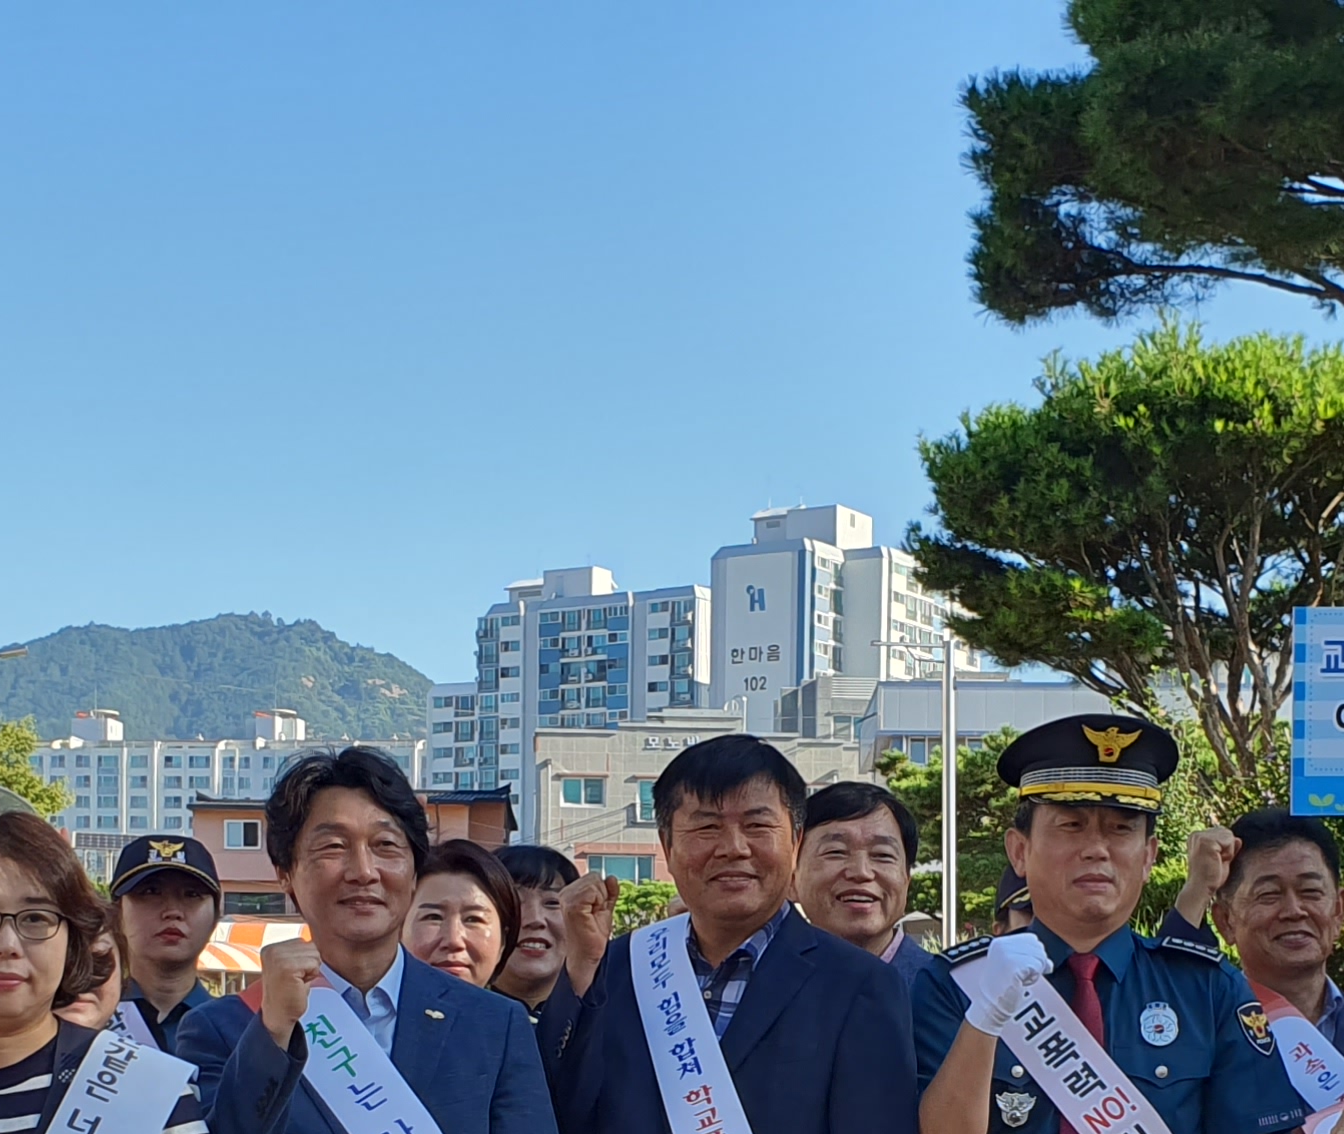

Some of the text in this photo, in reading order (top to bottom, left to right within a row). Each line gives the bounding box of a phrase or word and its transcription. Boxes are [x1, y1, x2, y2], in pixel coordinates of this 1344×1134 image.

[731, 644, 781, 664] 한마음
[744, 676, 767, 691] 102
[646, 927, 674, 992] 우리모두
[657, 992, 688, 1037] 힘을
[305, 1014, 387, 1111] 친구는
[669, 1037, 703, 1080] 합쳐
[1015, 995, 1108, 1098] 교폭력
[1289, 1042, 1340, 1091] 과속은
